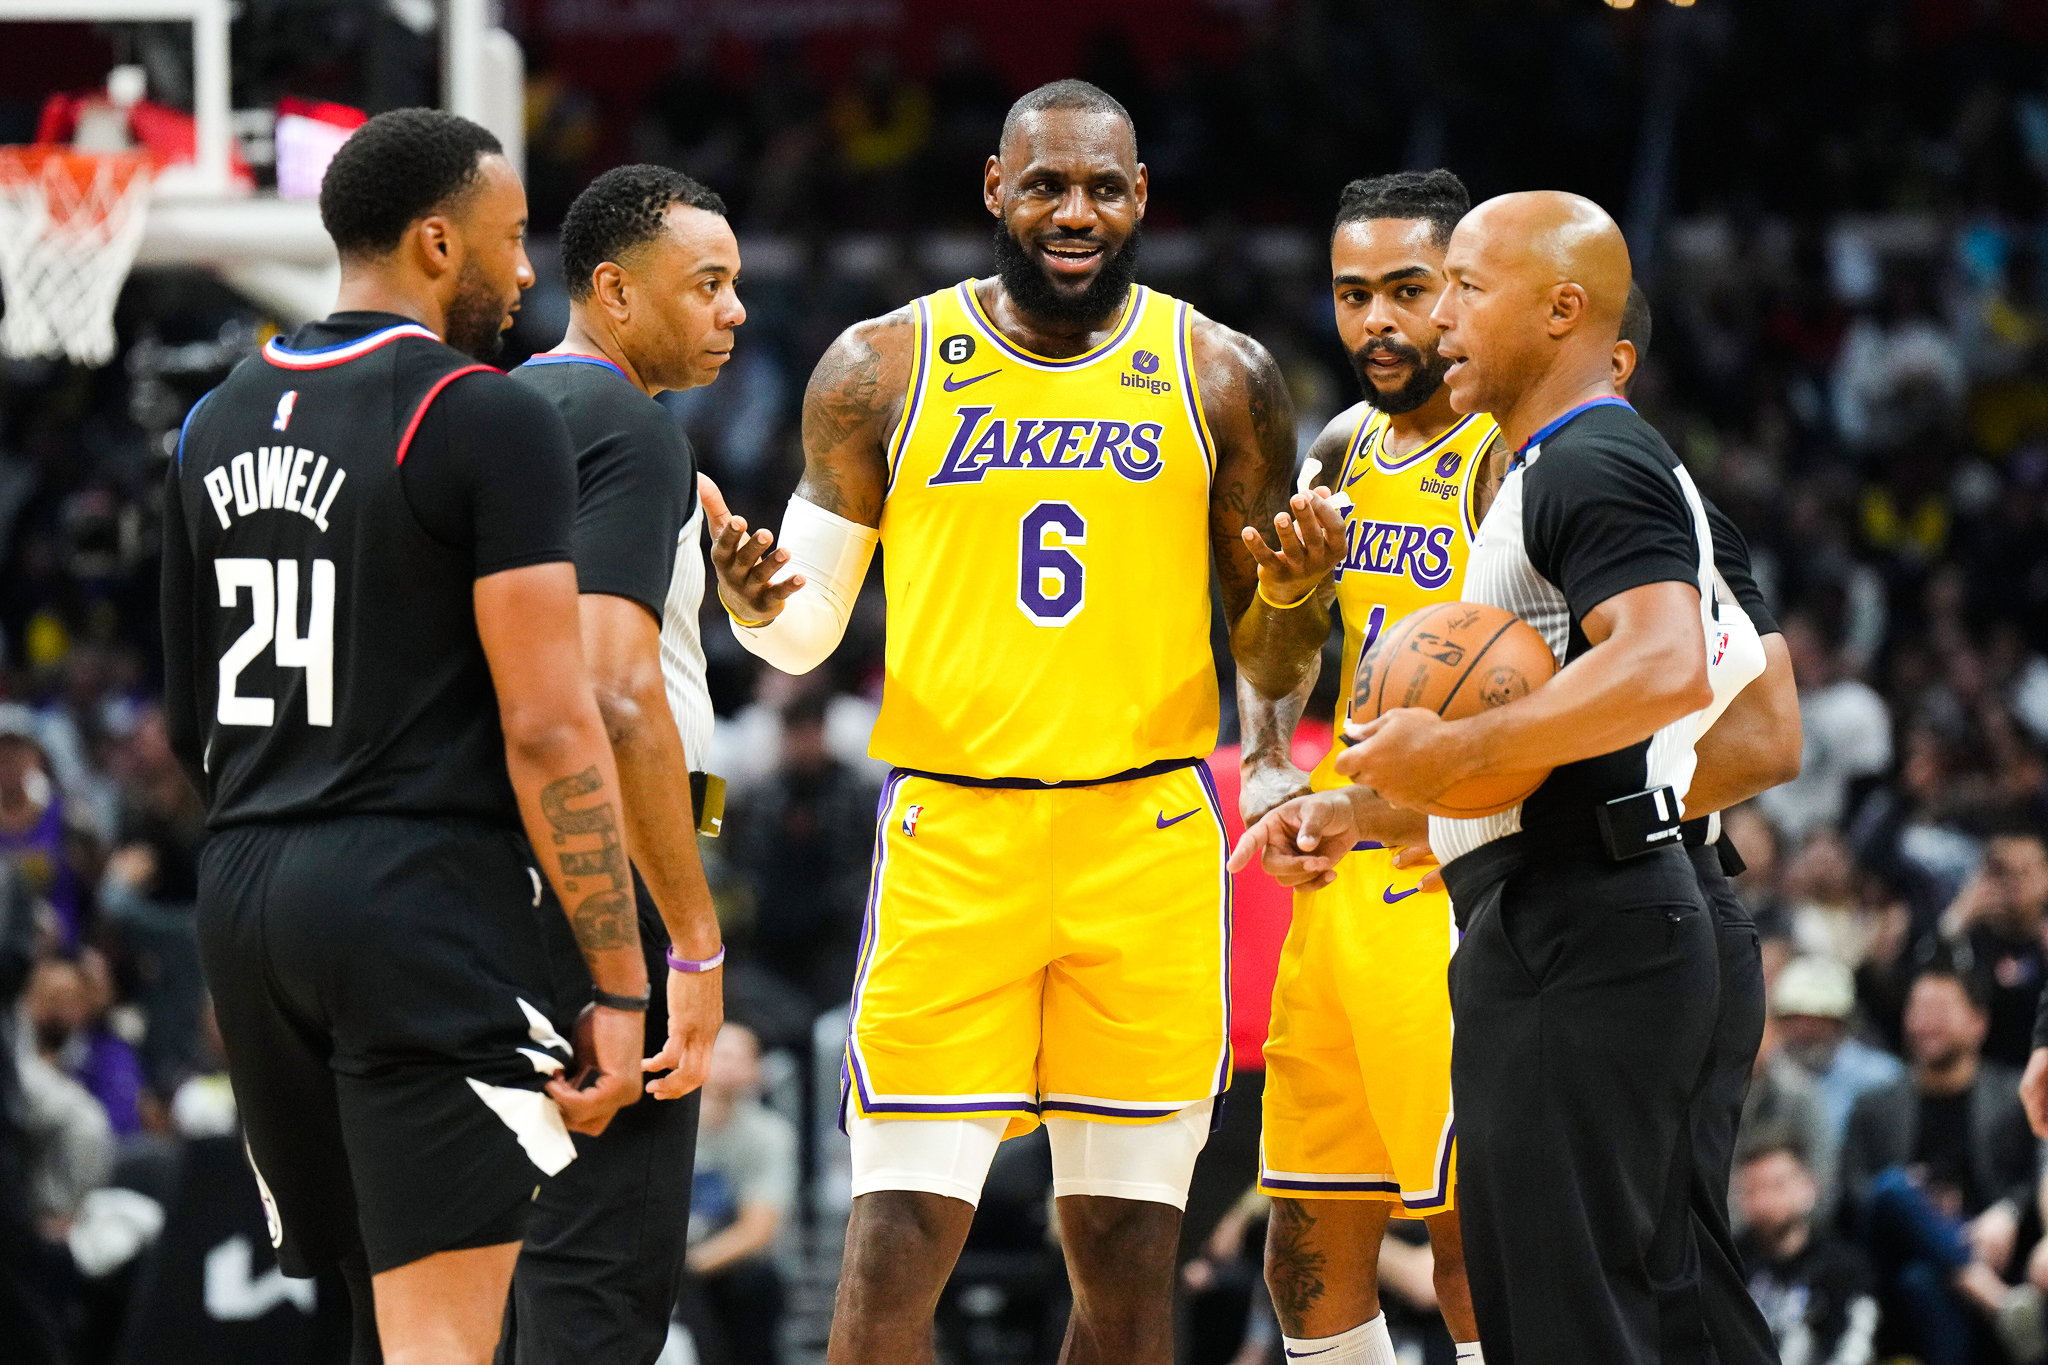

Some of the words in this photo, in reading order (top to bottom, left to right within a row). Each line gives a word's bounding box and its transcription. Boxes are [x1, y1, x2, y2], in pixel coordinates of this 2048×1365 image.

[949, 338, 967, 361] 6
[1121, 372, 1171, 395] bibigo
[925, 404, 1165, 488] LAKERS
[1420, 476, 1459, 500] bibigo
[203, 446, 346, 532] POWELL
[1016, 500, 1087, 628] 6
[1334, 503, 1456, 591] AKERS
[214, 558, 335, 727] 24
